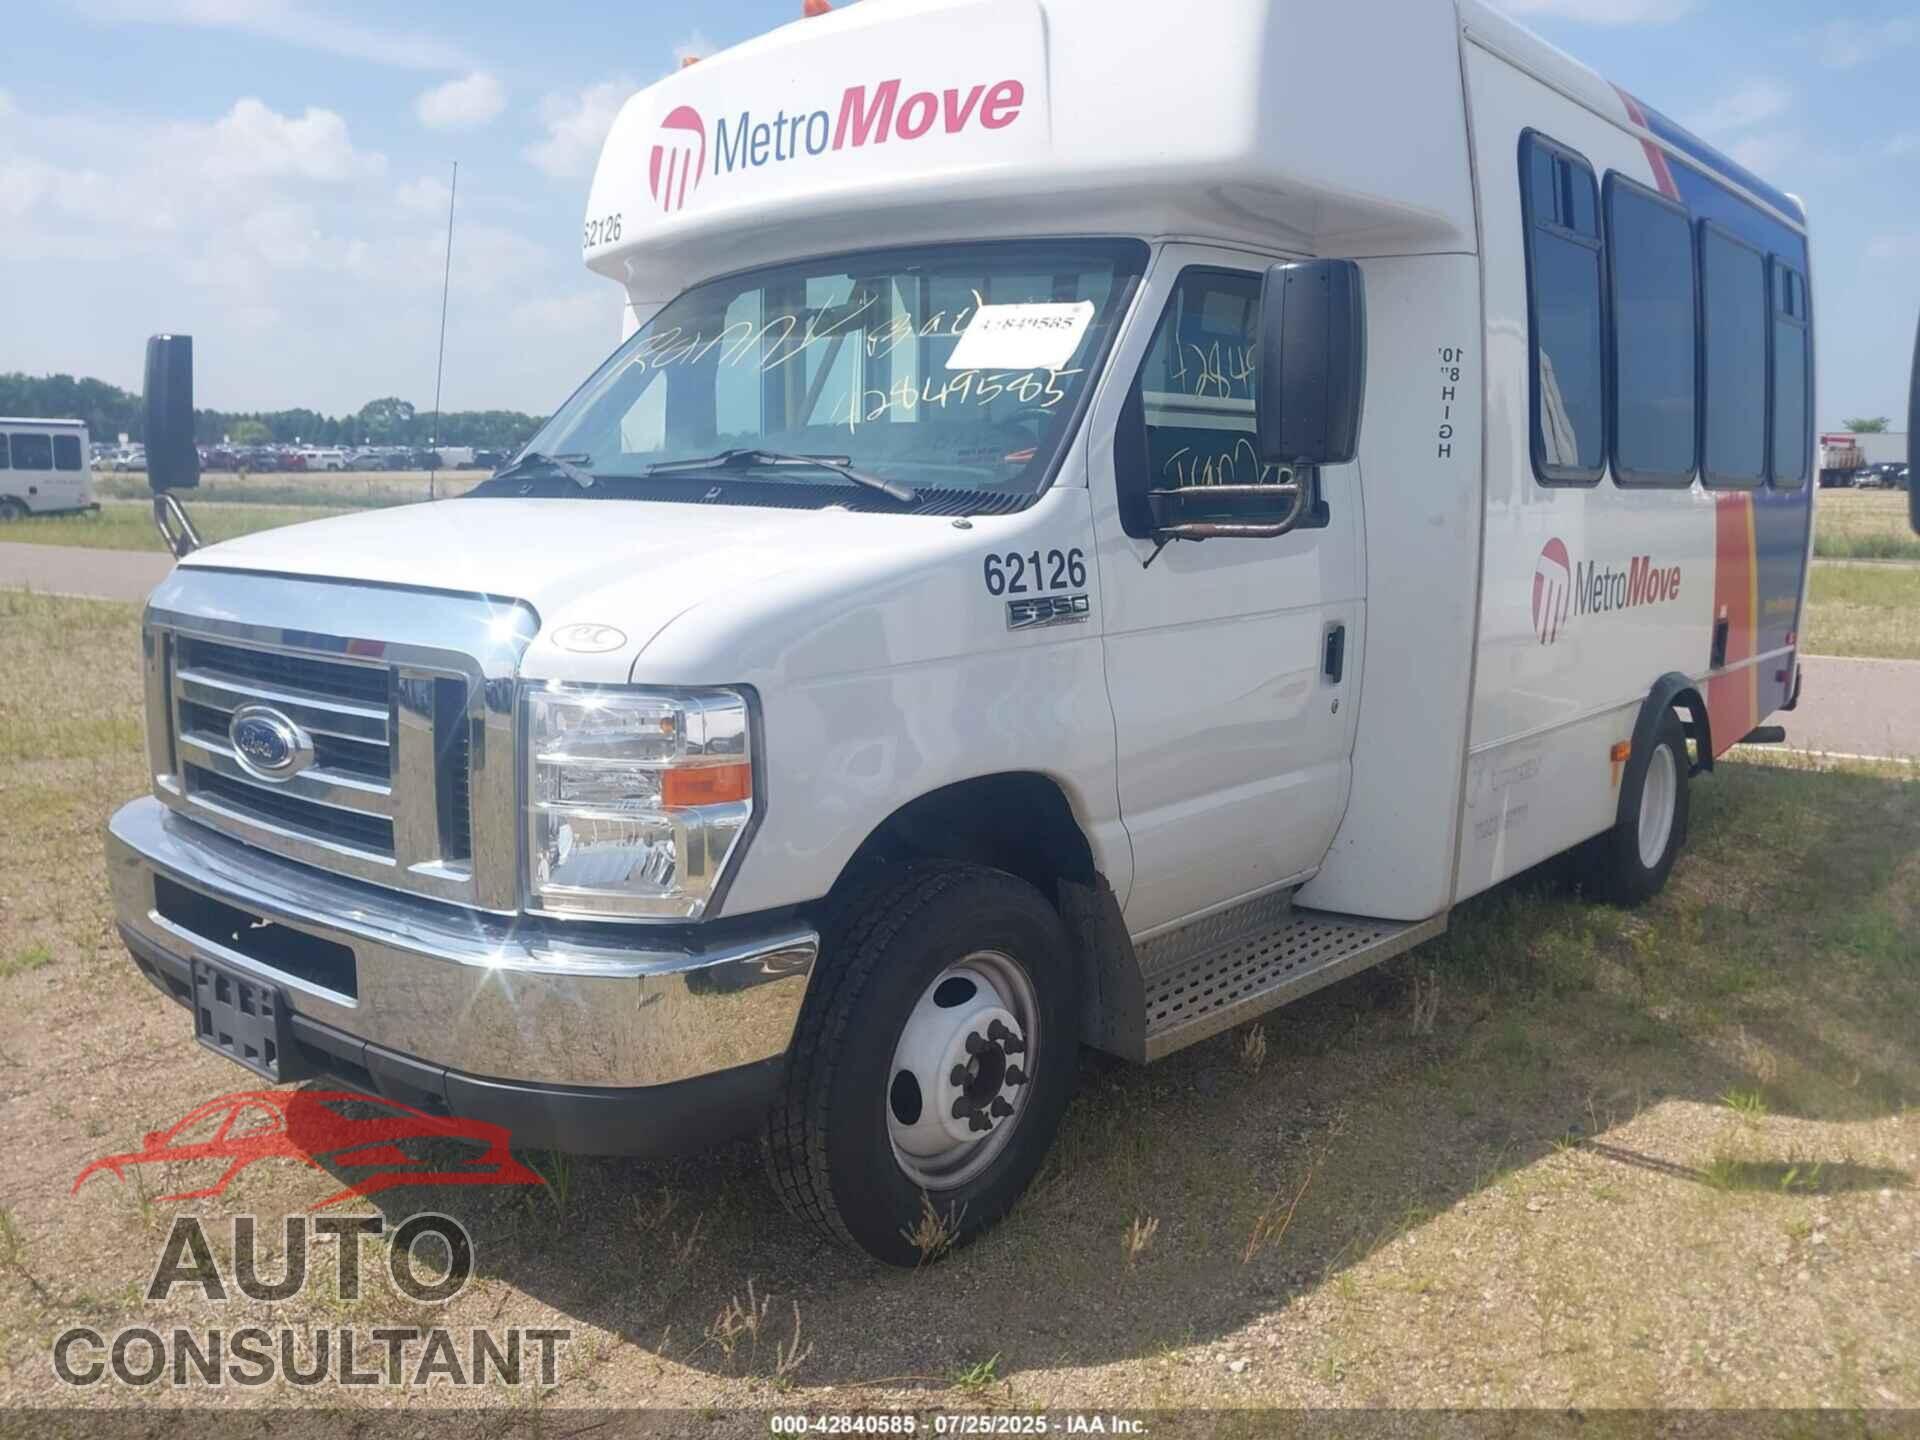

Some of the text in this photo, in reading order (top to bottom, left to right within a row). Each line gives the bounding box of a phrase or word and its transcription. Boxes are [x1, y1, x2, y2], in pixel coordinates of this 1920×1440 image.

[713, 78, 1025, 176] MetroMove
[983, 547, 1087, 596] 62126
[1573, 555, 1681, 617] MetroMove
